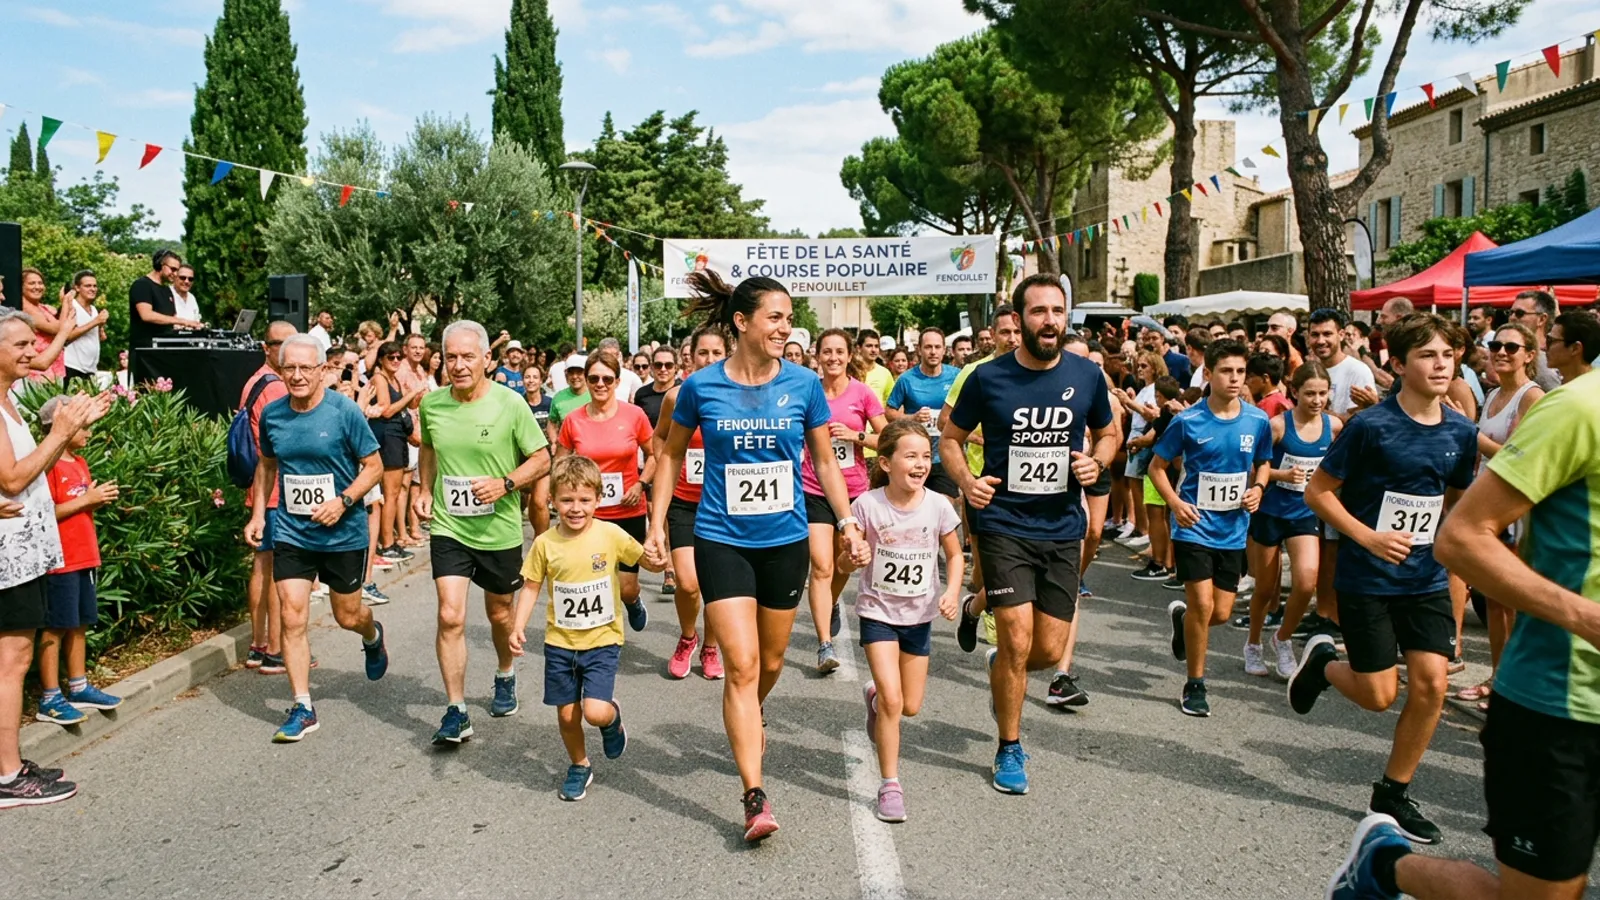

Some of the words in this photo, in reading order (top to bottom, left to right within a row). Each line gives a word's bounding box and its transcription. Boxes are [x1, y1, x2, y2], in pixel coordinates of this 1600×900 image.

[746, 242, 789, 260] FÊTE
[796, 246, 818, 259] DE
[825, 245, 847, 259] LA
[853, 240, 911, 259] SANTÉ
[731, 264, 742, 278] &
[748, 264, 820, 278] COURSE
[826, 262, 928, 277] POPULAIRE
[791, 281, 867, 292] PENOUILLET
[716, 418, 792, 431] FENOUILLET
[1011, 407, 1074, 430] SUD
[1011, 431, 1070, 444] SPORTS
[1019, 462, 1058, 482] 242
[292, 488, 325, 505] 208
[738, 478, 778, 502] 241
[1208, 485, 1239, 502] 115
[1390, 509, 1432, 533] 312
[883, 562, 923, 585] 243
[562, 594, 604, 618] 244
